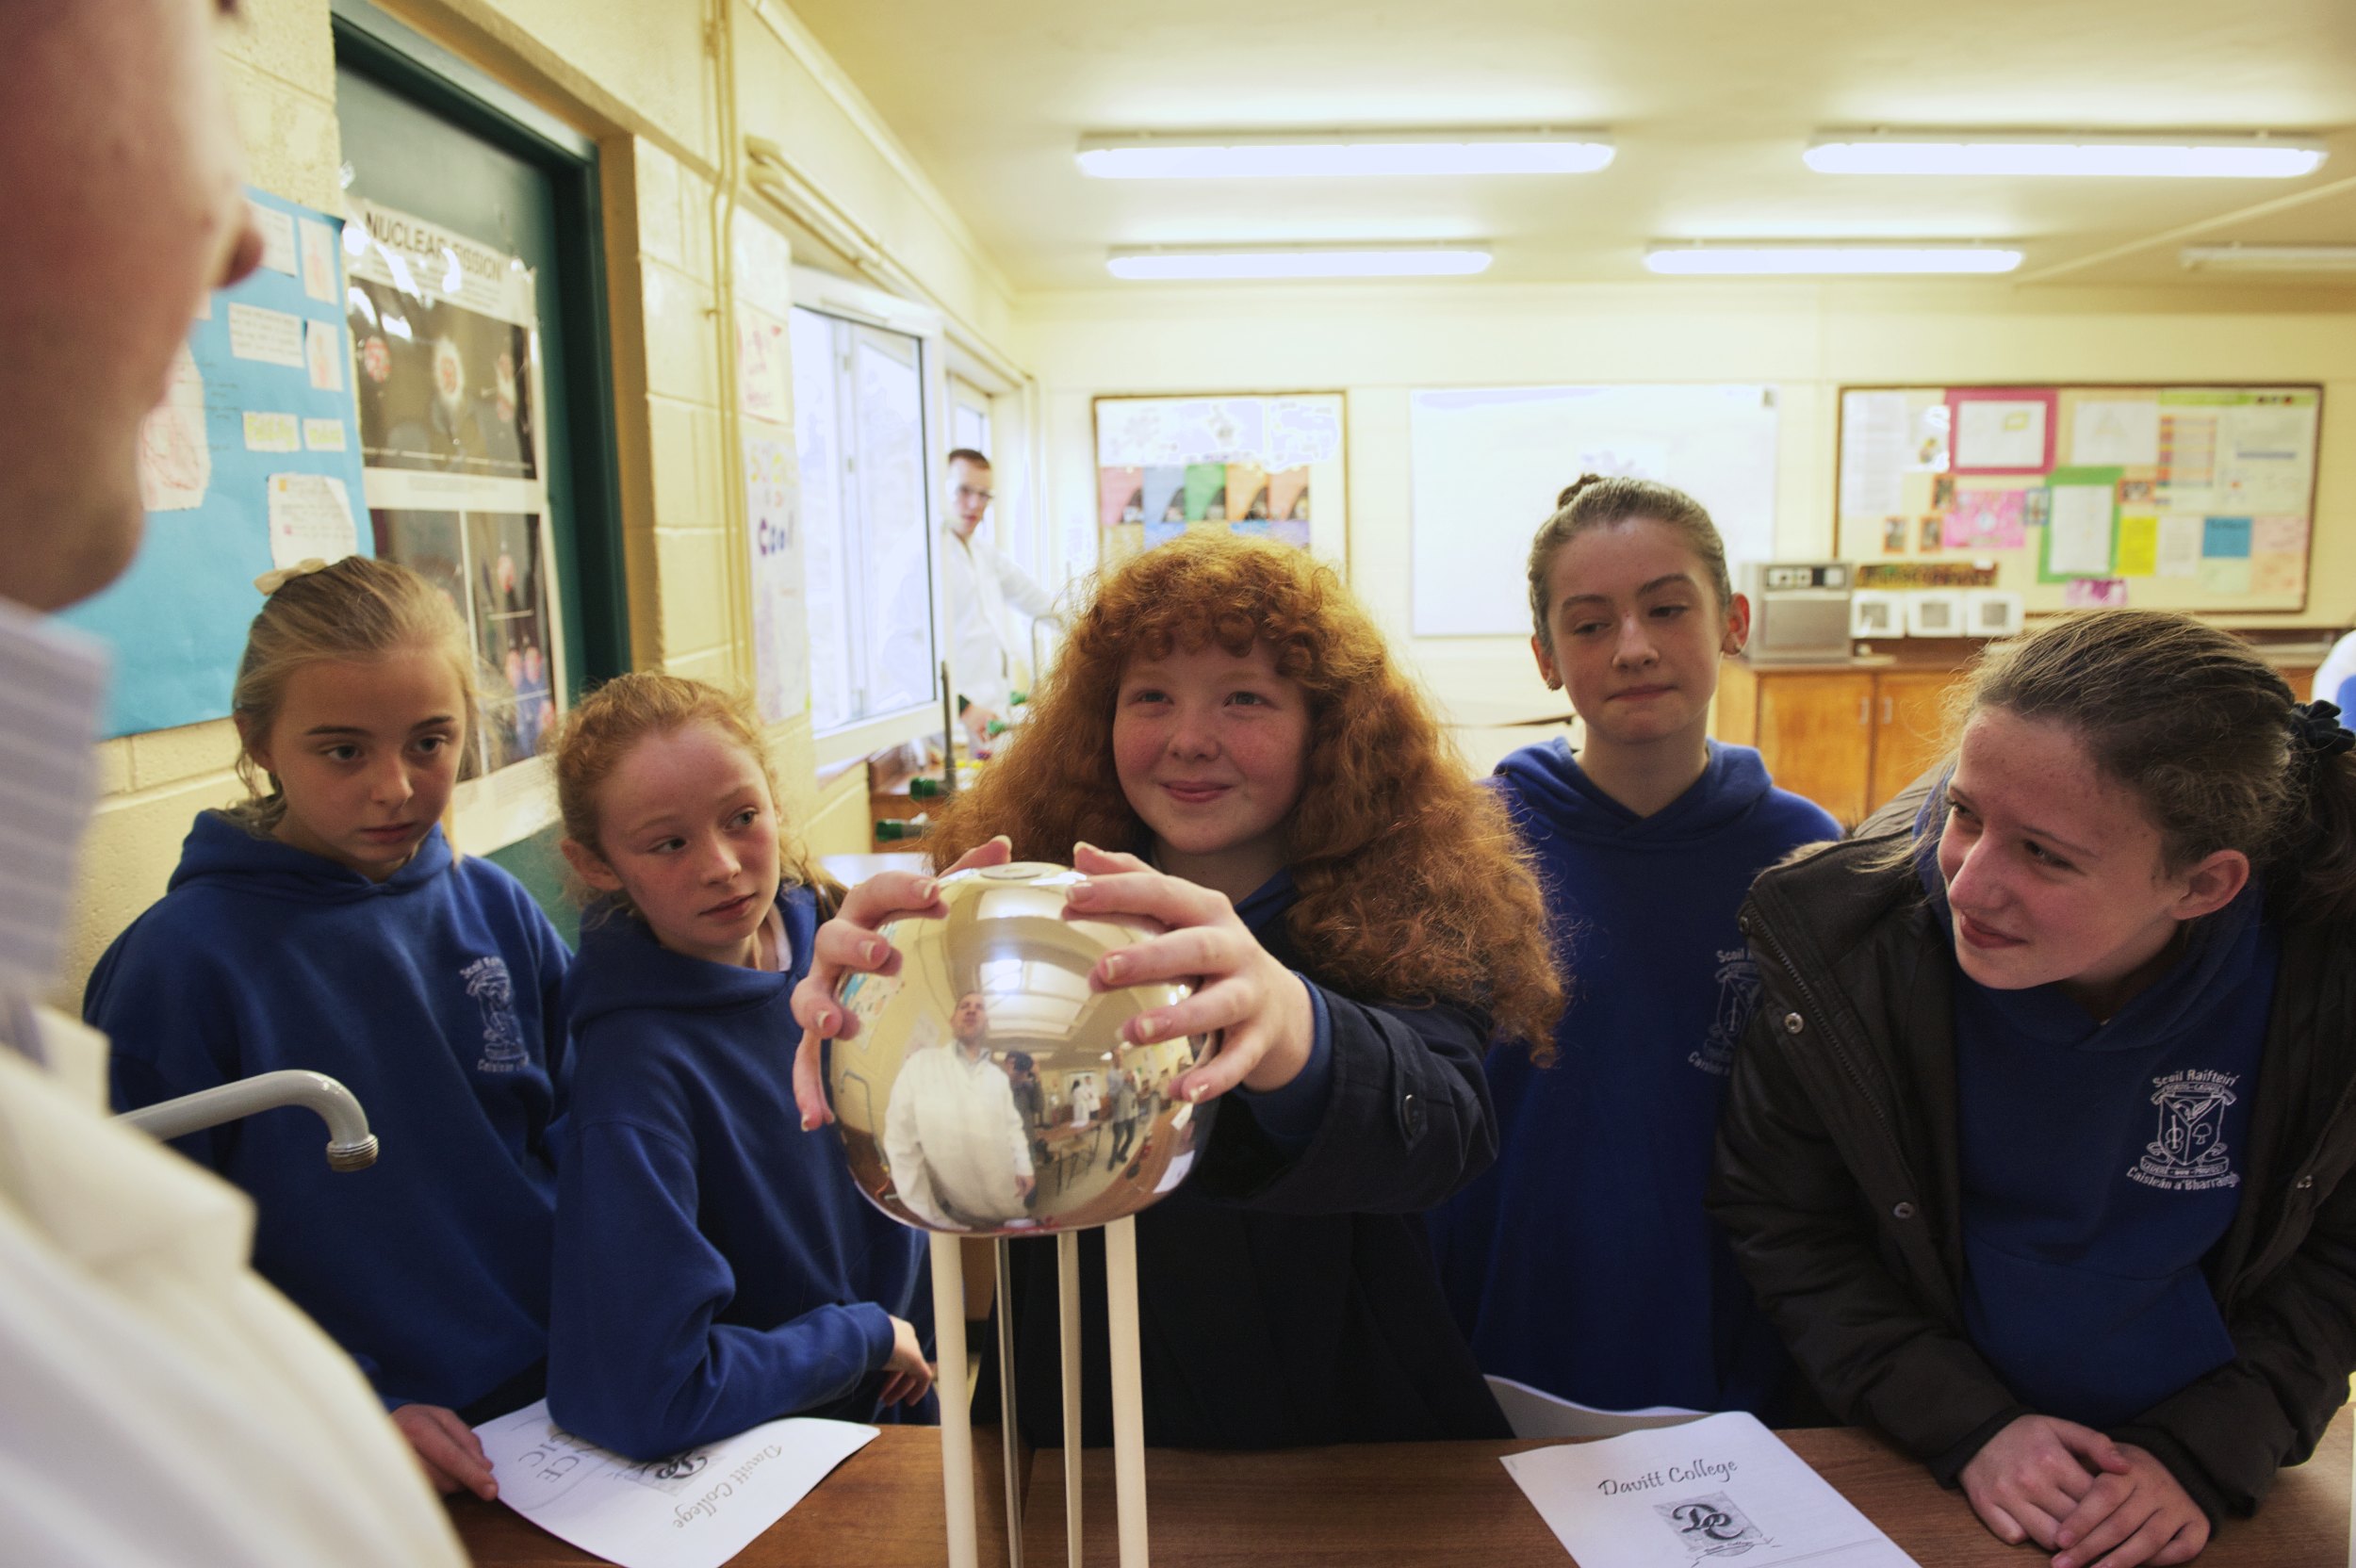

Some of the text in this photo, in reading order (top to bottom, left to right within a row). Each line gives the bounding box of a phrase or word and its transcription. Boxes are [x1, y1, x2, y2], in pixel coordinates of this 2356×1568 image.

[366, 211, 449, 258] NUCLEAR
[2152, 1070, 2184, 1088] Scoil
[672, 1444, 782, 1529] Davitt College
[1597, 1459, 1738, 1495] Davitt College
